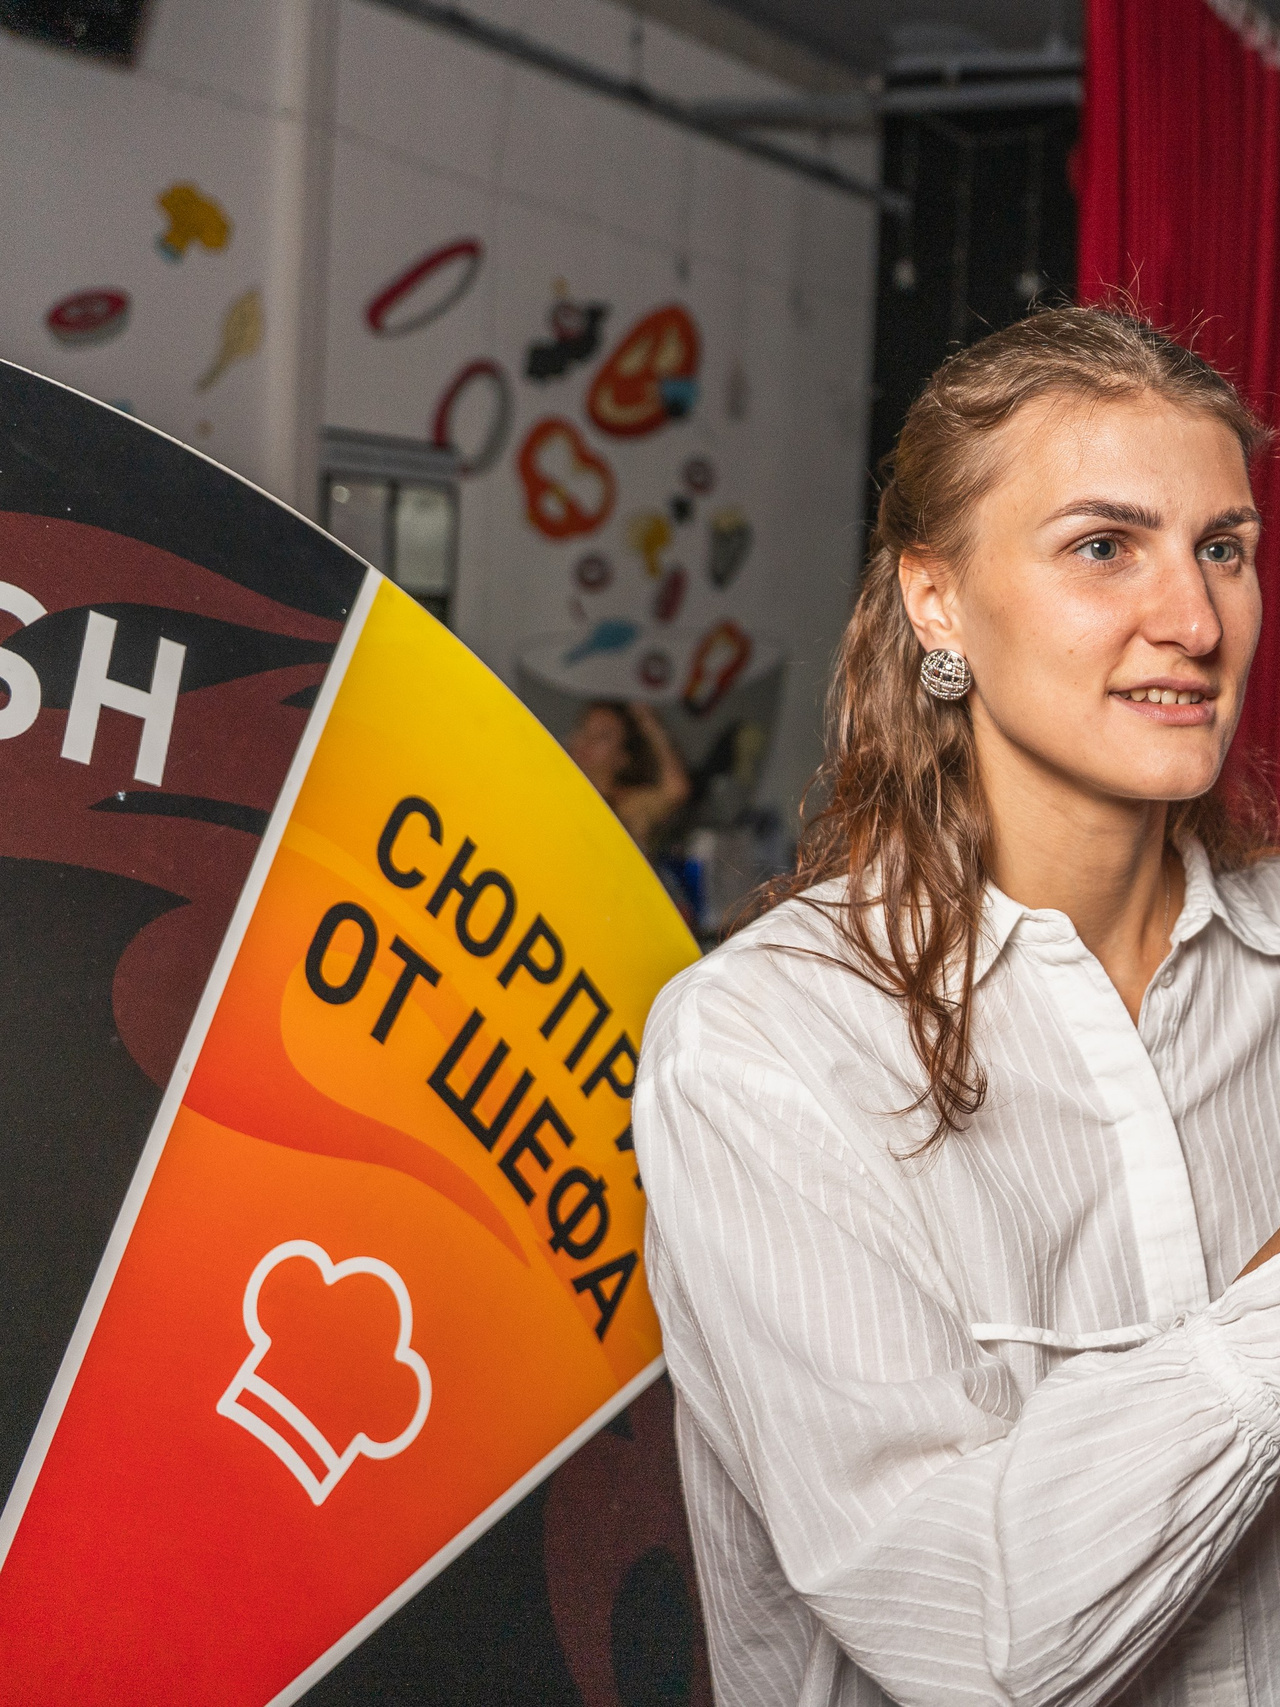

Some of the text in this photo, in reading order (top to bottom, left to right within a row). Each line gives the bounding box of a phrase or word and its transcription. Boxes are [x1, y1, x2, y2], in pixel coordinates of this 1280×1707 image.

[304, 901, 639, 1343] ОТ ШЕФА
[376, 795, 643, 1192] СЮРПР
